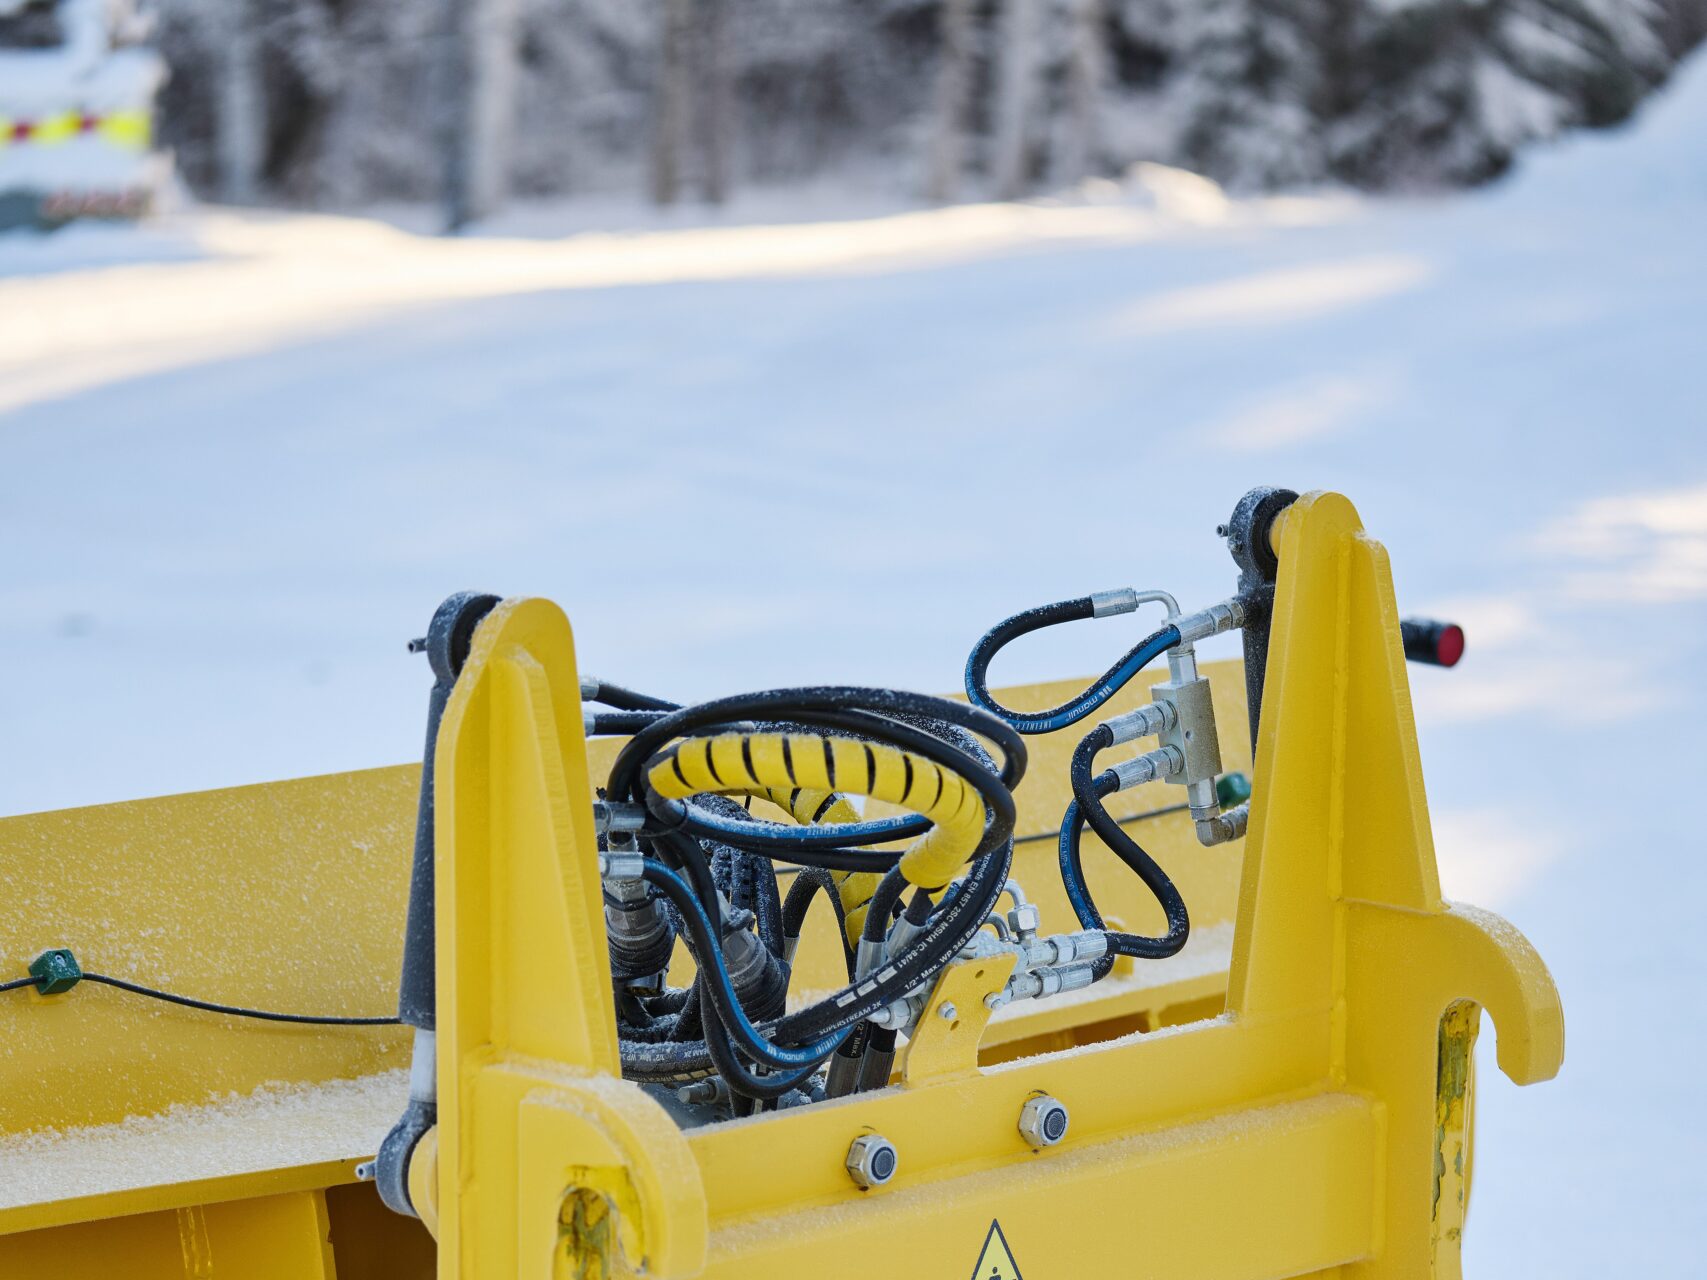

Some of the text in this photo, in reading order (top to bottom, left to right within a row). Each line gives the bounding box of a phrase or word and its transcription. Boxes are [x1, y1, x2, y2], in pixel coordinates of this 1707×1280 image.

[967, 881, 979, 895] EN
[960, 894, 973, 908] 857
[948, 907, 962, 923] 2SC
[925, 920, 949, 943] MSHA
[939, 950, 953, 963] WP
[953, 938, 967, 952] 345
[965, 924, 978, 939] Bar
